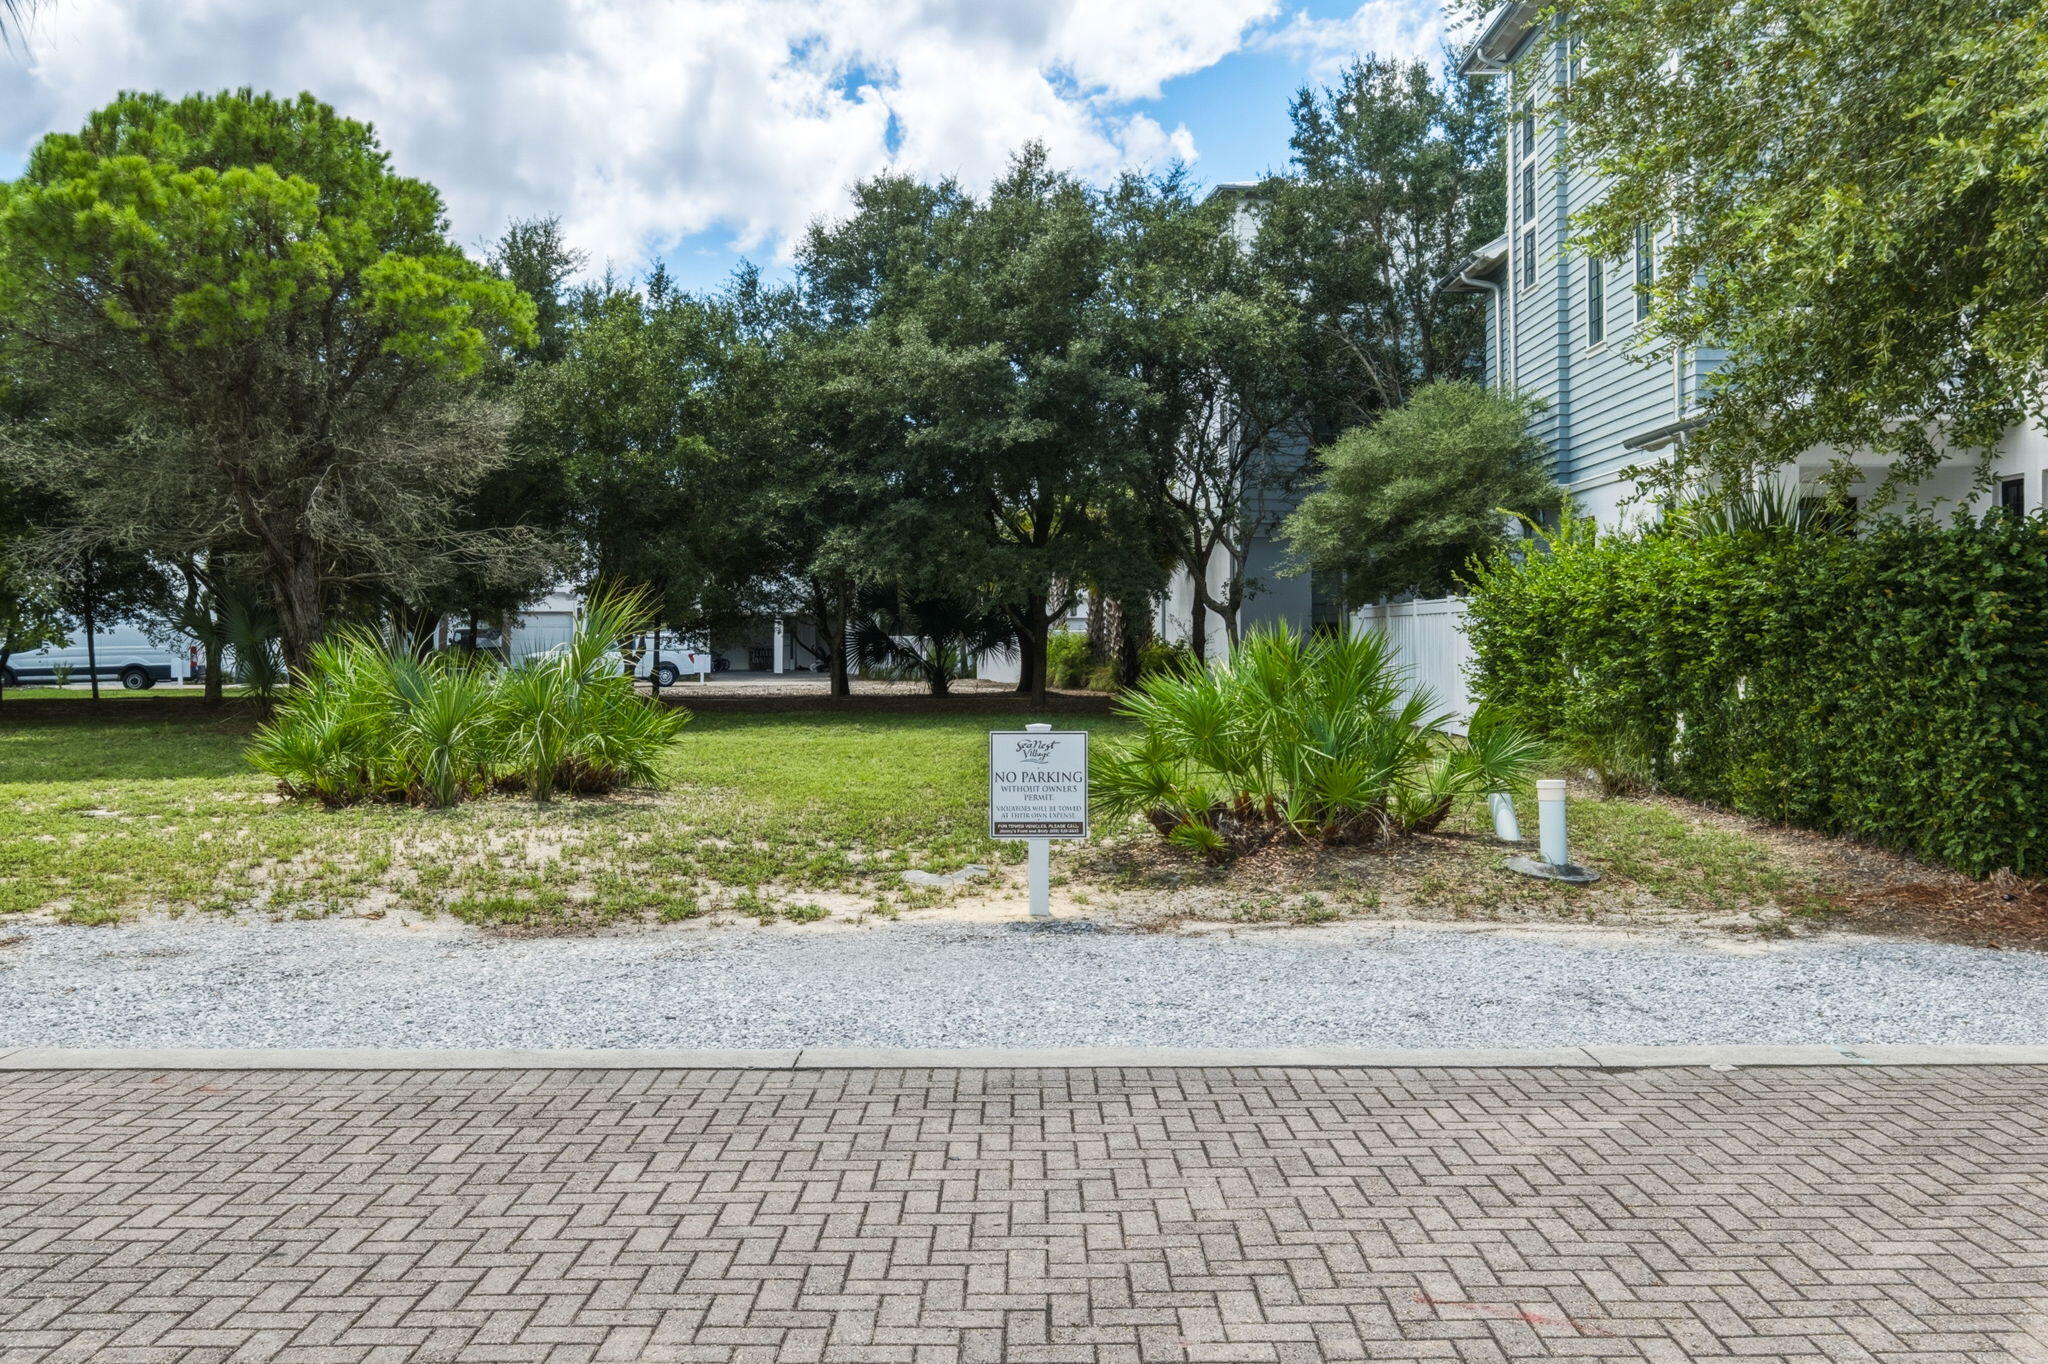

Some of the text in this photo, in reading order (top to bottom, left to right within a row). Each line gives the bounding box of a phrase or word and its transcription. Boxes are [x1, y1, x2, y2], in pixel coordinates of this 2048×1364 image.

[1023, 749, 1050, 760] Village
[995, 771, 1083, 783] NO PARKING
